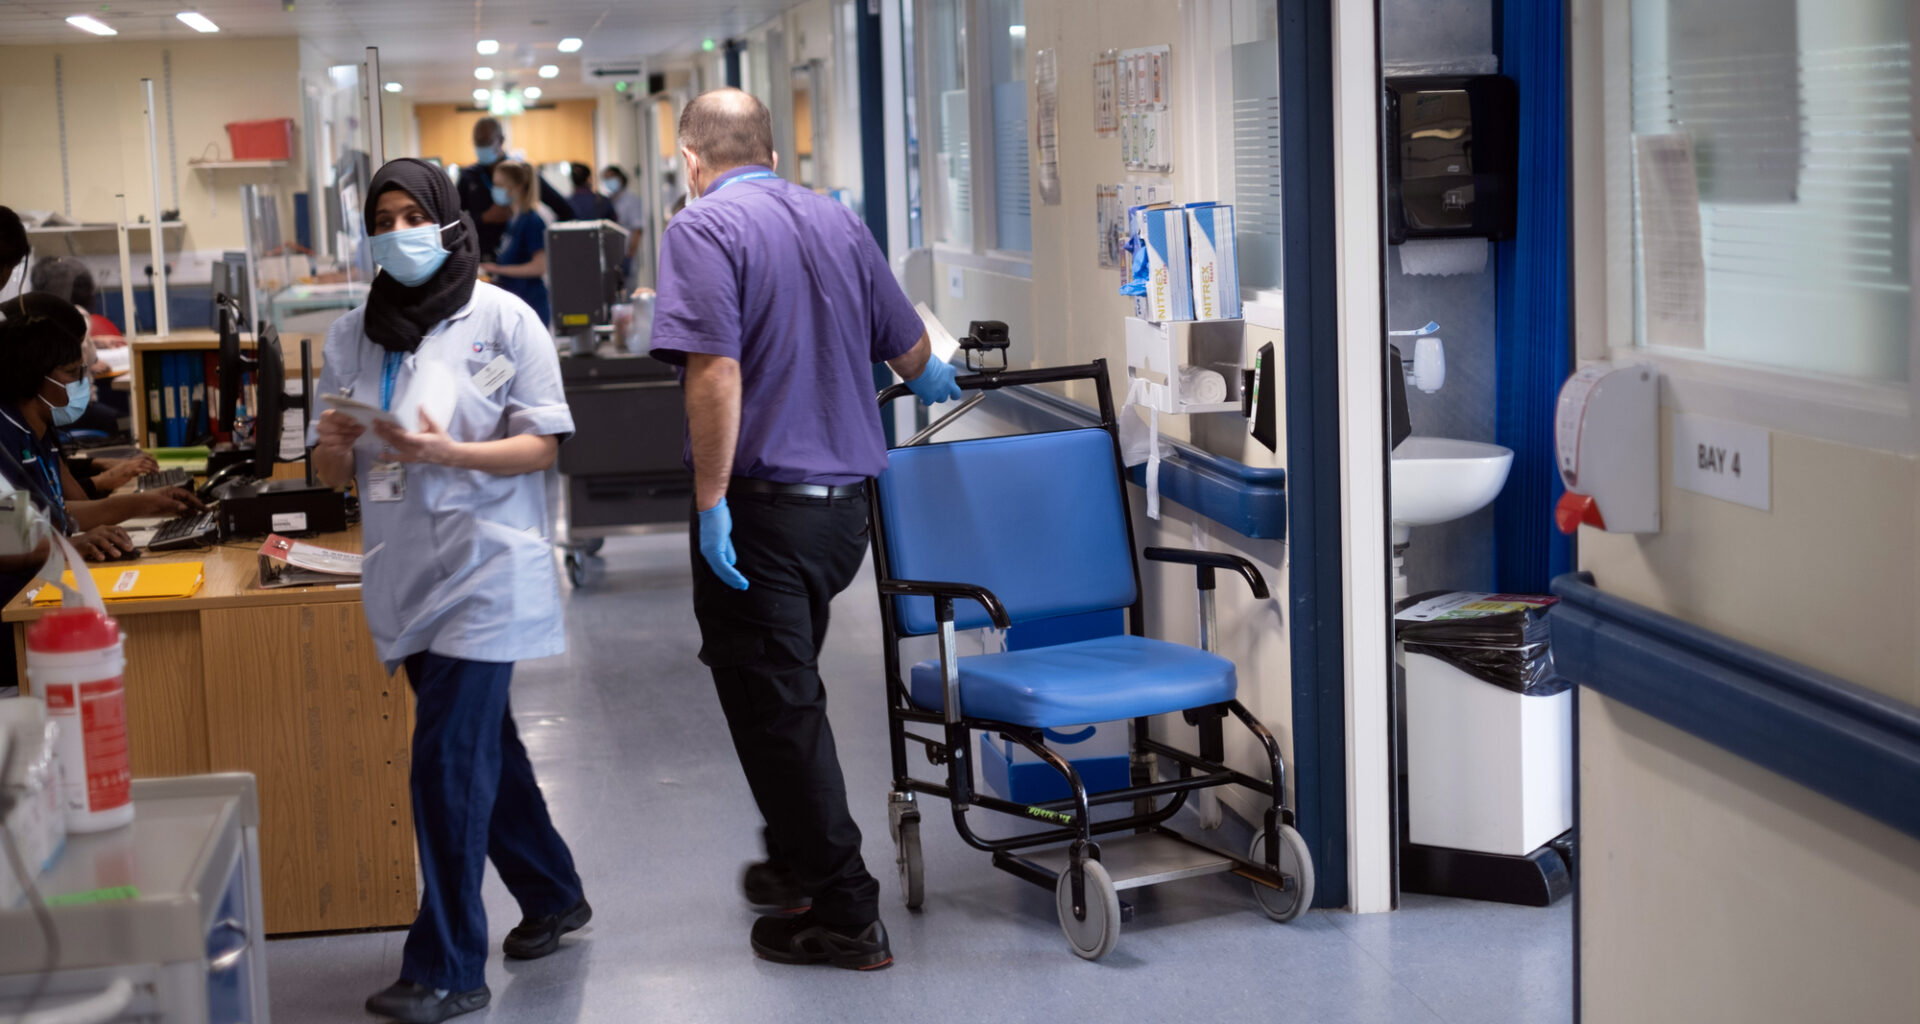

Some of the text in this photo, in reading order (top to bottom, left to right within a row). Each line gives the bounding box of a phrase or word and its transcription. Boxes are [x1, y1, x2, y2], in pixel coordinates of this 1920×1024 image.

[1155, 268, 1165, 319] NITREX
[1202, 266, 1212, 317] NITREX
[1698, 443, 1741, 478] BAY 4
